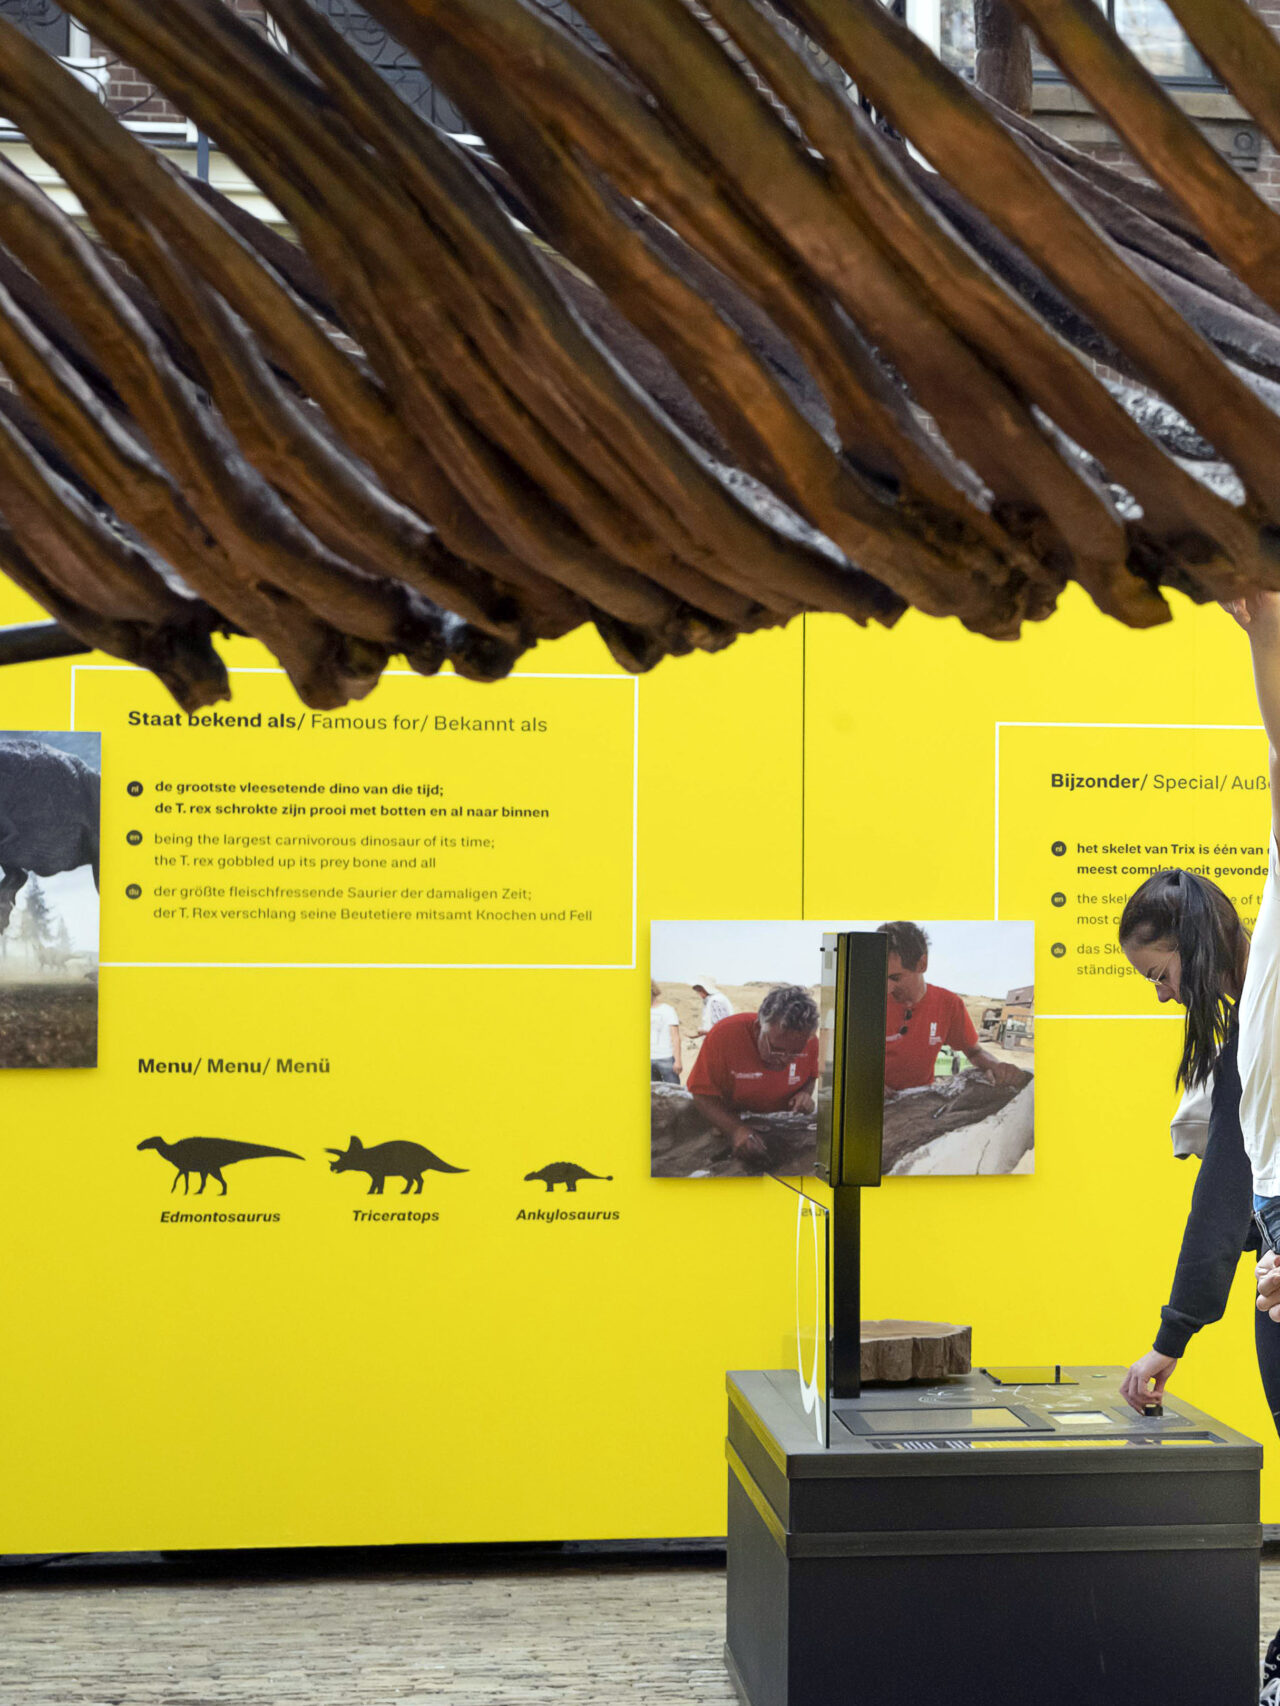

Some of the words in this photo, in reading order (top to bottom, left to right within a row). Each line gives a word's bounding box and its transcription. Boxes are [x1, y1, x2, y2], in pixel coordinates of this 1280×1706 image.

[128, 711, 182, 726] Staat
[188, 712, 262, 727] bekend
[268, 713, 305, 730] als/
[312, 713, 387, 729] Famous
[393, 715, 428, 732] for/
[435, 716, 514, 731] Bekannt
[521, 717, 547, 732] als
[155, 781, 172, 791] de
[177, 783, 236, 794] grootste
[240, 782, 325, 793] vleesetende
[330, 784, 359, 794] dino
[363, 786, 388, 794] van
[392, 784, 412, 794] die
[417, 784, 443, 797] tijd;
[1052, 774, 1148, 791] Bijzonder/
[1154, 775, 1227, 792] Special/
[155, 803, 172, 813] de
[176, 803, 186, 813] T.
[216, 804, 277, 814] schrokte
[282, 804, 305, 817] zijn
[310, 805, 346, 817] prooi
[350, 806, 376, 815] met
[381, 805, 425, 816] botten
[430, 808, 446, 816] en
[451, 806, 462, 816] al
[467, 809, 498, 817] naar
[502, 807, 549, 817] binnen
[155, 834, 192, 847] being
[198, 834, 219, 844] the
[224, 834, 270, 848] largest
[276, 834, 356, 846] carnivorous
[361, 836, 420, 847] dinosaur
[424, 836, 436, 847] of
[441, 837, 456, 847] its
[461, 837, 494, 848] time;
[1077, 843, 1097, 853] het
[1102, 844, 1141, 854] skelet
[1145, 846, 1168, 854] van
[1171, 844, 1195, 854] Trix
[1199, 844, 1209, 854] is
[1214, 844, 1237, 855] één
[1241, 847, 1263, 855] van
[155, 855, 176, 865] the
[181, 855, 189, 865] T.
[194, 858, 213, 866] rex
[218, 856, 274, 869] gobbled
[279, 859, 295, 869] up
[300, 857, 316, 867] its
[321, 859, 349, 870] prey
[353, 857, 387, 867] bone
[391, 858, 416, 868] and
[421, 858, 435, 868] all
[1077, 865, 1117, 874] meest
[1214, 866, 1268, 878] gevonde
[154, 886, 176, 896] der
[180, 886, 225, 899] größte
[230, 886, 343, 898] fleischfressende
[348, 887, 397, 898] Saurier
[401, 888, 423, 898] der
[427, 888, 497, 902] damaligen
[502, 888, 531, 901] Zeit;
[1077, 894, 1097, 904] the
[1241, 894, 1253, 905] of
[153, 908, 176, 918] der
[179, 907, 188, 918] T.
[193, 908, 217, 918] Rex
[220, 908, 295, 921] verschlang
[301, 909, 336, 919] seine
[341, 909, 412, 920] Beutetiere
[416, 910, 471, 920] mitsamt
[477, 910, 536, 920] Knochen
[540, 910, 565, 920] und
[570, 910, 592, 921] Fell
[1077, 915, 1108, 925] most
[1077, 944, 1100, 954] das
[139, 1058, 201, 1075] Menu/
[208, 1058, 270, 1075] Menu/
[277, 1058, 329, 1073] Menü
[161, 1211, 280, 1223] Edmontosaurus
[353, 1210, 439, 1224] Triceratops
[516, 1209, 619, 1223] Ankylosaurus
